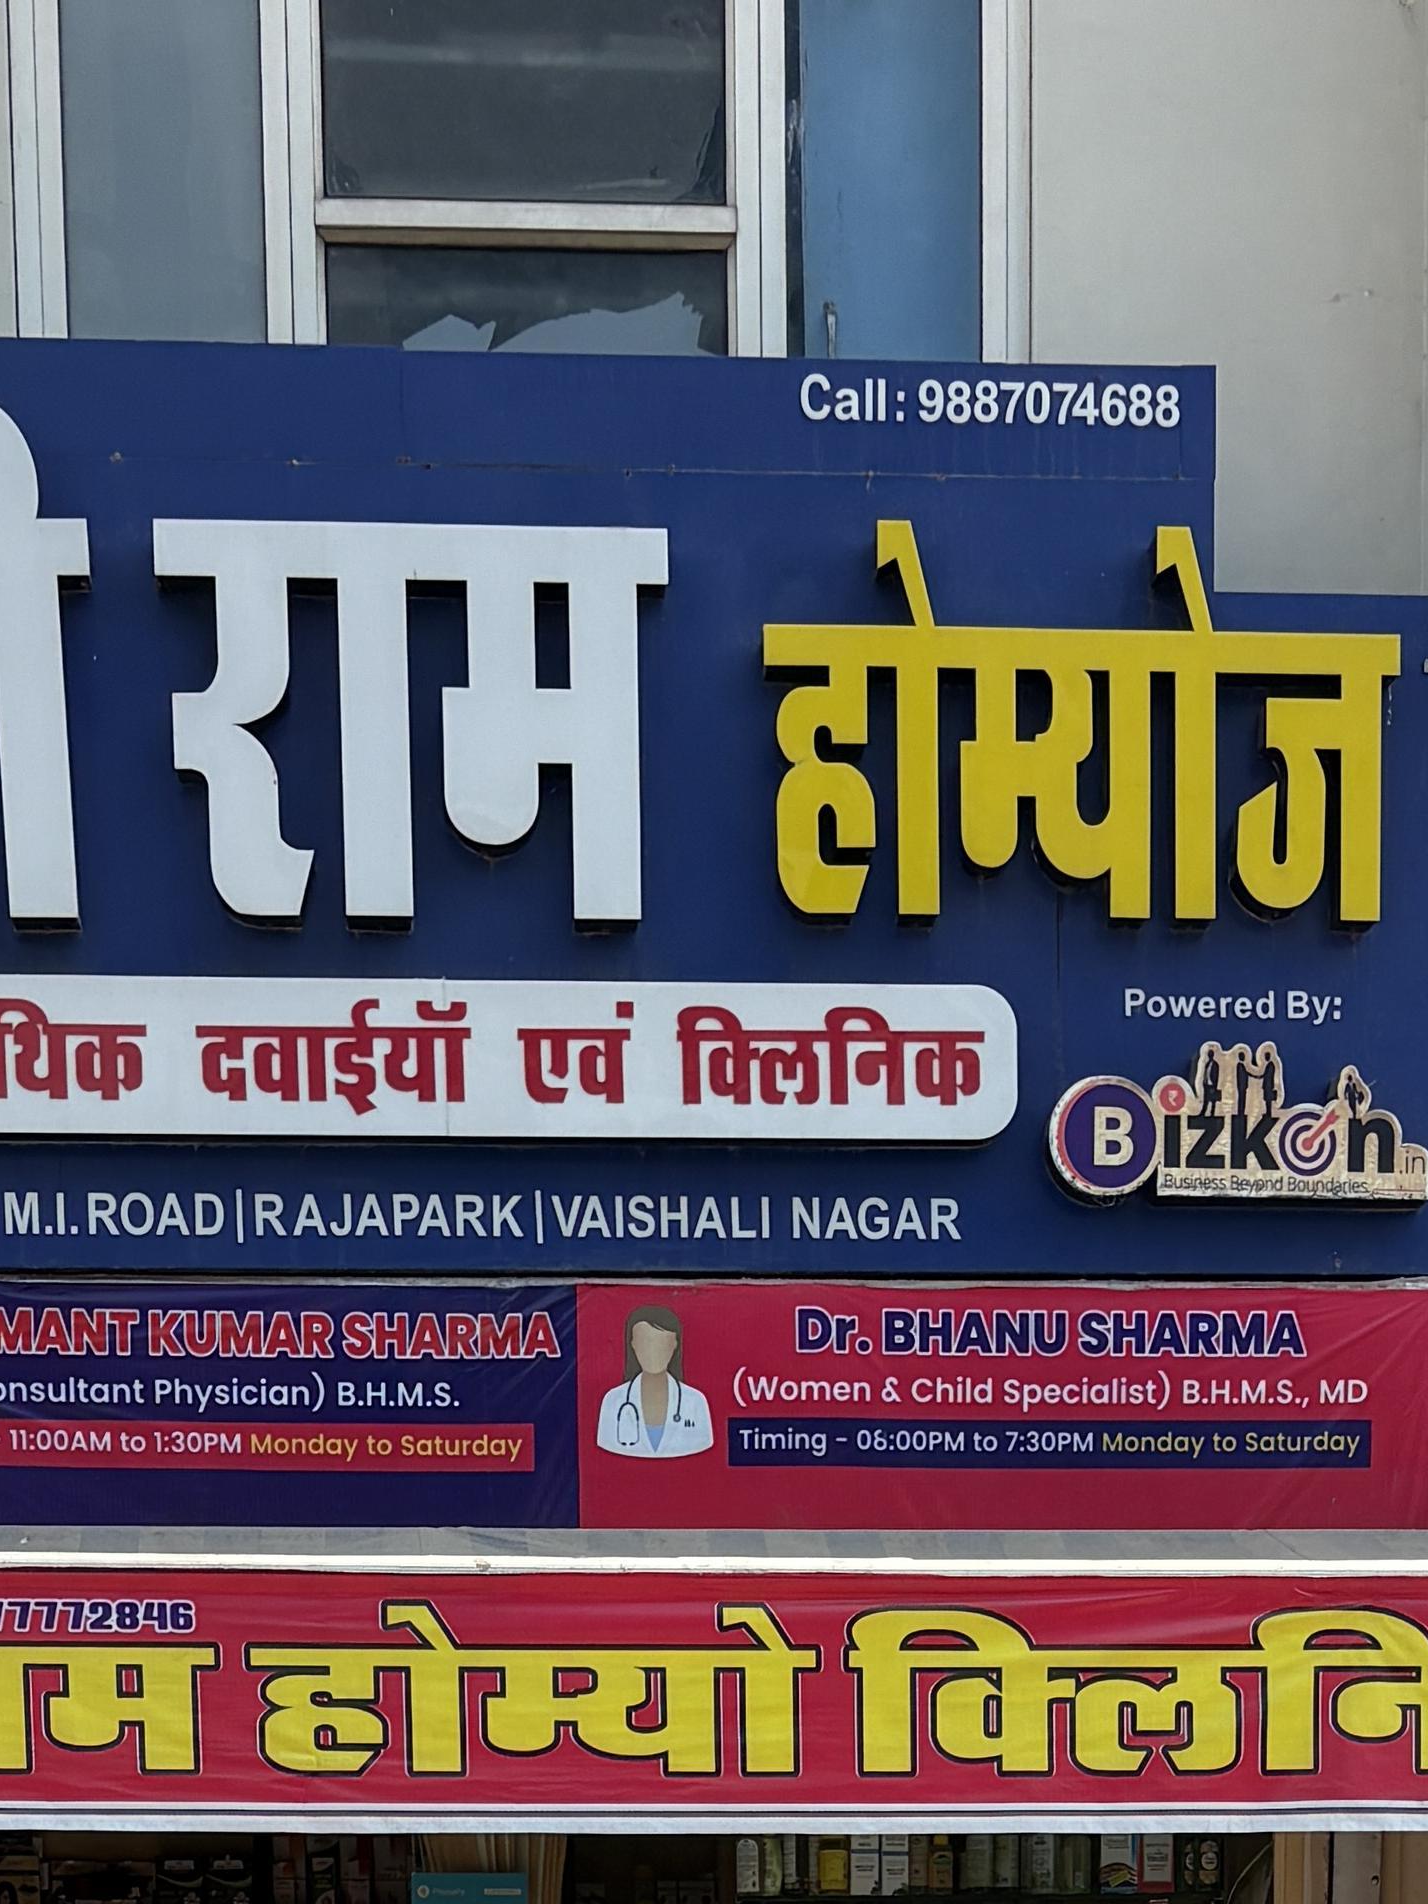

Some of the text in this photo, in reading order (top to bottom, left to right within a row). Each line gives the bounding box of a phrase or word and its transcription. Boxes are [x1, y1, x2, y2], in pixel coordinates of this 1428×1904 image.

[800, 373, 1181, 428] Call: 9887074688
[153, 518, 669, 922] राम
[762, 520, 1401, 922] होम्योज
[1124, 988, 1342, 1025] Powered By:
[518, 1002, 632, 1105] एवं
[677, 1006, 984, 1107] क्लिनिक
[1164, 1175, 1226, 1191] Business
[1231, 1176, 1283, 1194] Beyond
[791, 1198, 962, 1242] NAGAR
[147, 1309, 336, 1359] KUMAR
[342, 1311, 560, 1360] SHARMA
[795, 1306, 1307, 1358] Dr. BHANU SHARMA
[154, 1372, 327, 1413] Physician)
[337, 1382, 460, 1409] B.H.M.S.
[732, 1367, 1369, 1413] (Women & Child Specialist) B.H.M.S., MD
[9, 1428, 112, 1454] 11:00AM
[120, 1431, 147, 1455] to
[153, 1431, 242, 1456] 1:30PM
[250, 1432, 359, 1463] Monday
[366, 1434, 392, 1457] to
[400, 1434, 523, 1463] Saturday
[738, 1428, 827, 1460] Timing
[973, 1432, 998, 1453] to
[1005, 1431, 1094, 1454] 7:30PM
[1101, 1432, 1202, 1461] Monday
[1213, 1433, 1236, 1454] to
[1244, 1432, 1361, 1460] Saturday
[245, 1599, 822, 1778] होम्यो
